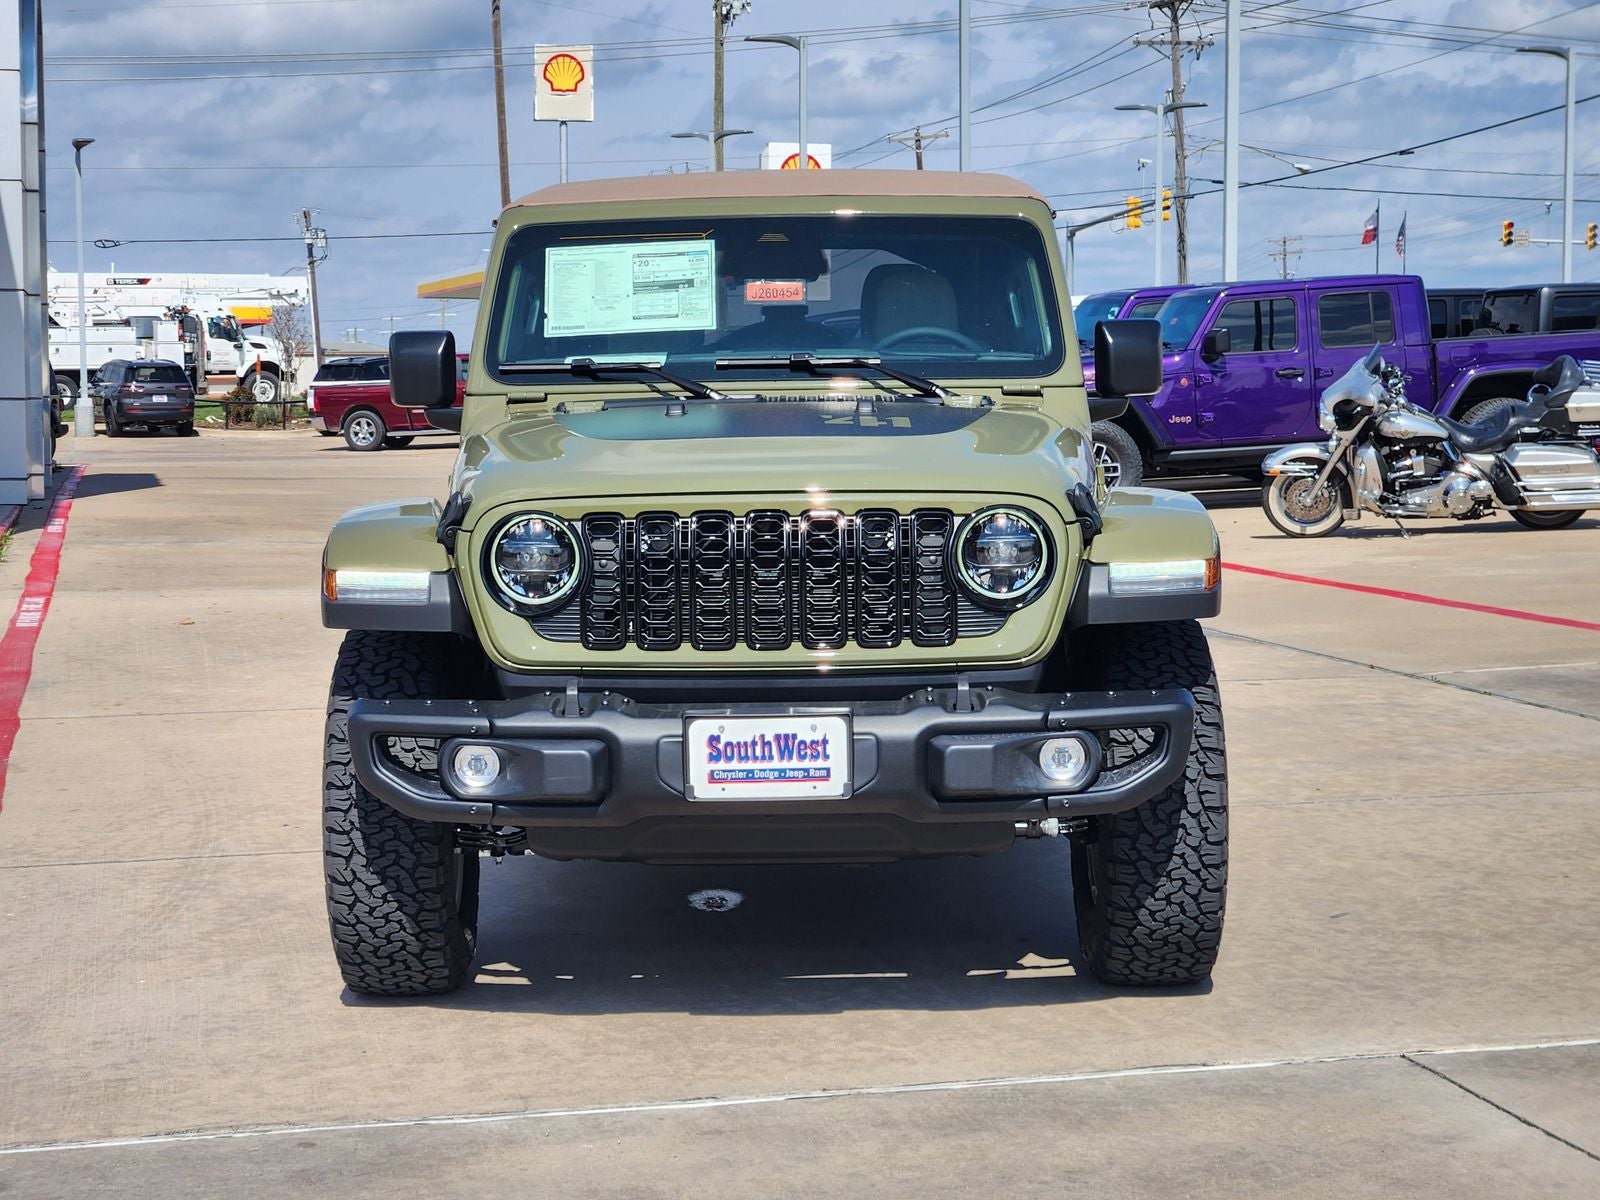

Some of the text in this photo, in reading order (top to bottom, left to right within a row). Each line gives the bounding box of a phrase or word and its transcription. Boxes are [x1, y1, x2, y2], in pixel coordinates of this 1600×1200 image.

[638, 259, 650, 267] 20
[751, 286, 800, 299] J260454
[1168, 415, 1192, 424] Jeep
[706, 732, 831, 764] SouthWest
[713, 768, 827, 780] Chrysler Dodge Jeep Ram
